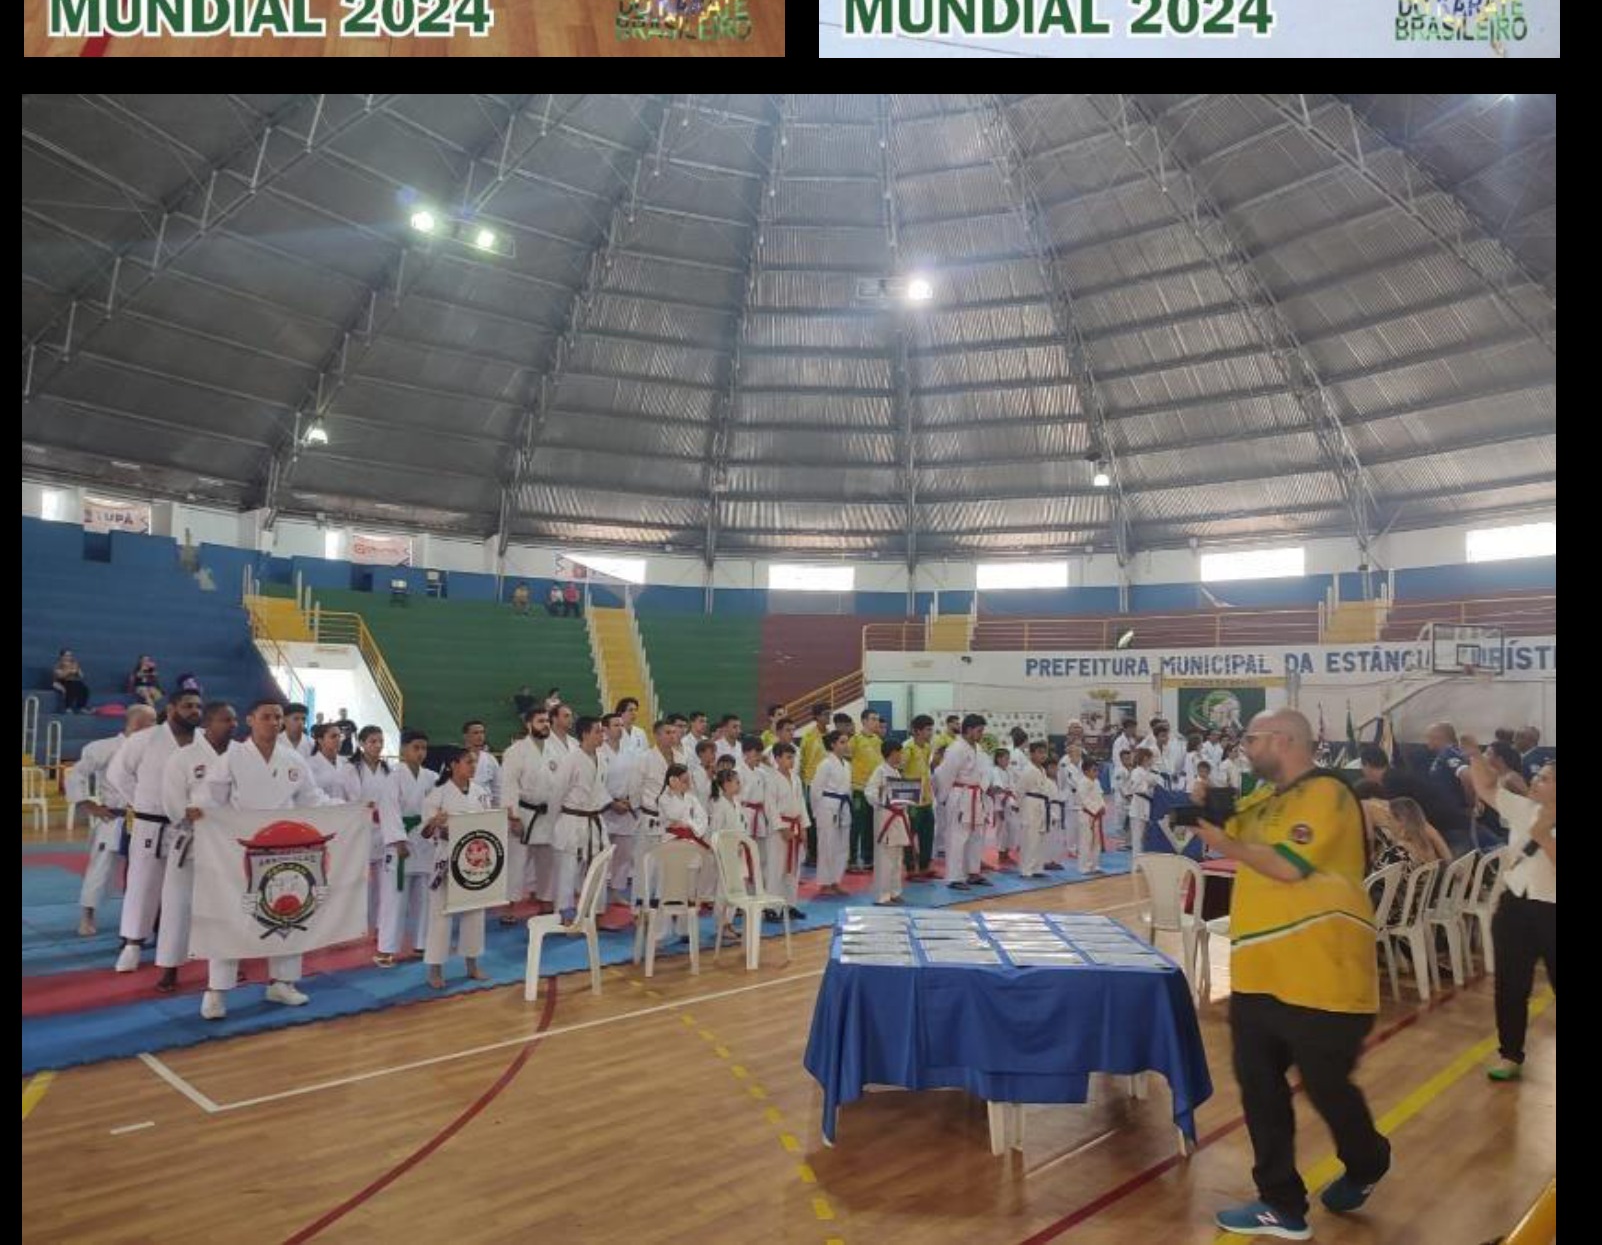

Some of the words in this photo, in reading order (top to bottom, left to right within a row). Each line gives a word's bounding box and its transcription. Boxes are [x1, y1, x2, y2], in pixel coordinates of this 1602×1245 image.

[1025, 656, 1150, 677] PREFEITURA
[1159, 653, 1273, 675] MUNICIPAL
[1284, 651, 1314, 675] DA
